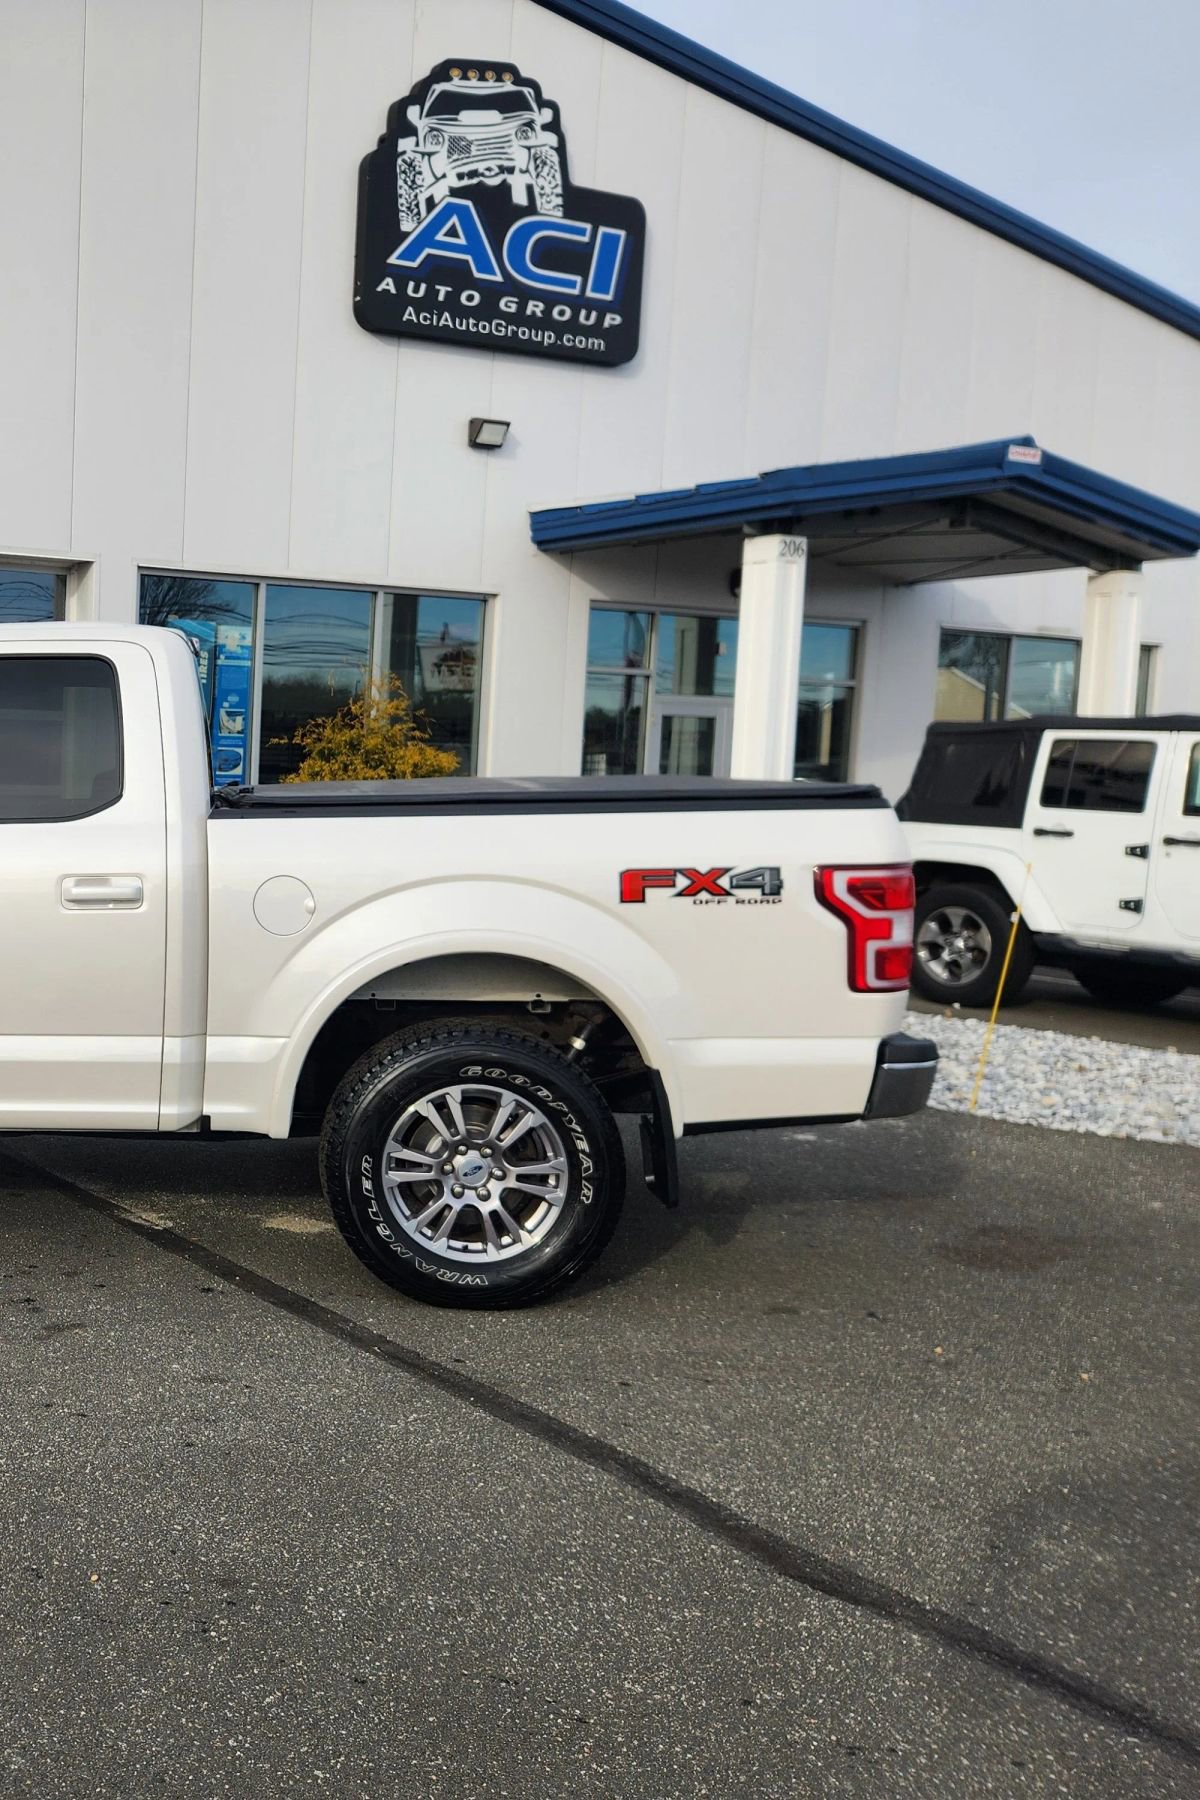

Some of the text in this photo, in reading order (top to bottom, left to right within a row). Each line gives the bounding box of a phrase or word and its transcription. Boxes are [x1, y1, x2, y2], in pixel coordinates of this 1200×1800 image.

[386, 196, 626, 301] ACI
[376, 277, 623, 330] AUTO GROUP
[402, 306, 606, 351] AciAutoGroup.com
[779, 539, 805, 558] 206
[619, 866, 784, 904] FX4
[692, 897, 783, 905] OFF ROAD
[459, 1065, 593, 1204] GOODYEAR
[362, 1154, 489, 1286] WRANGLER
